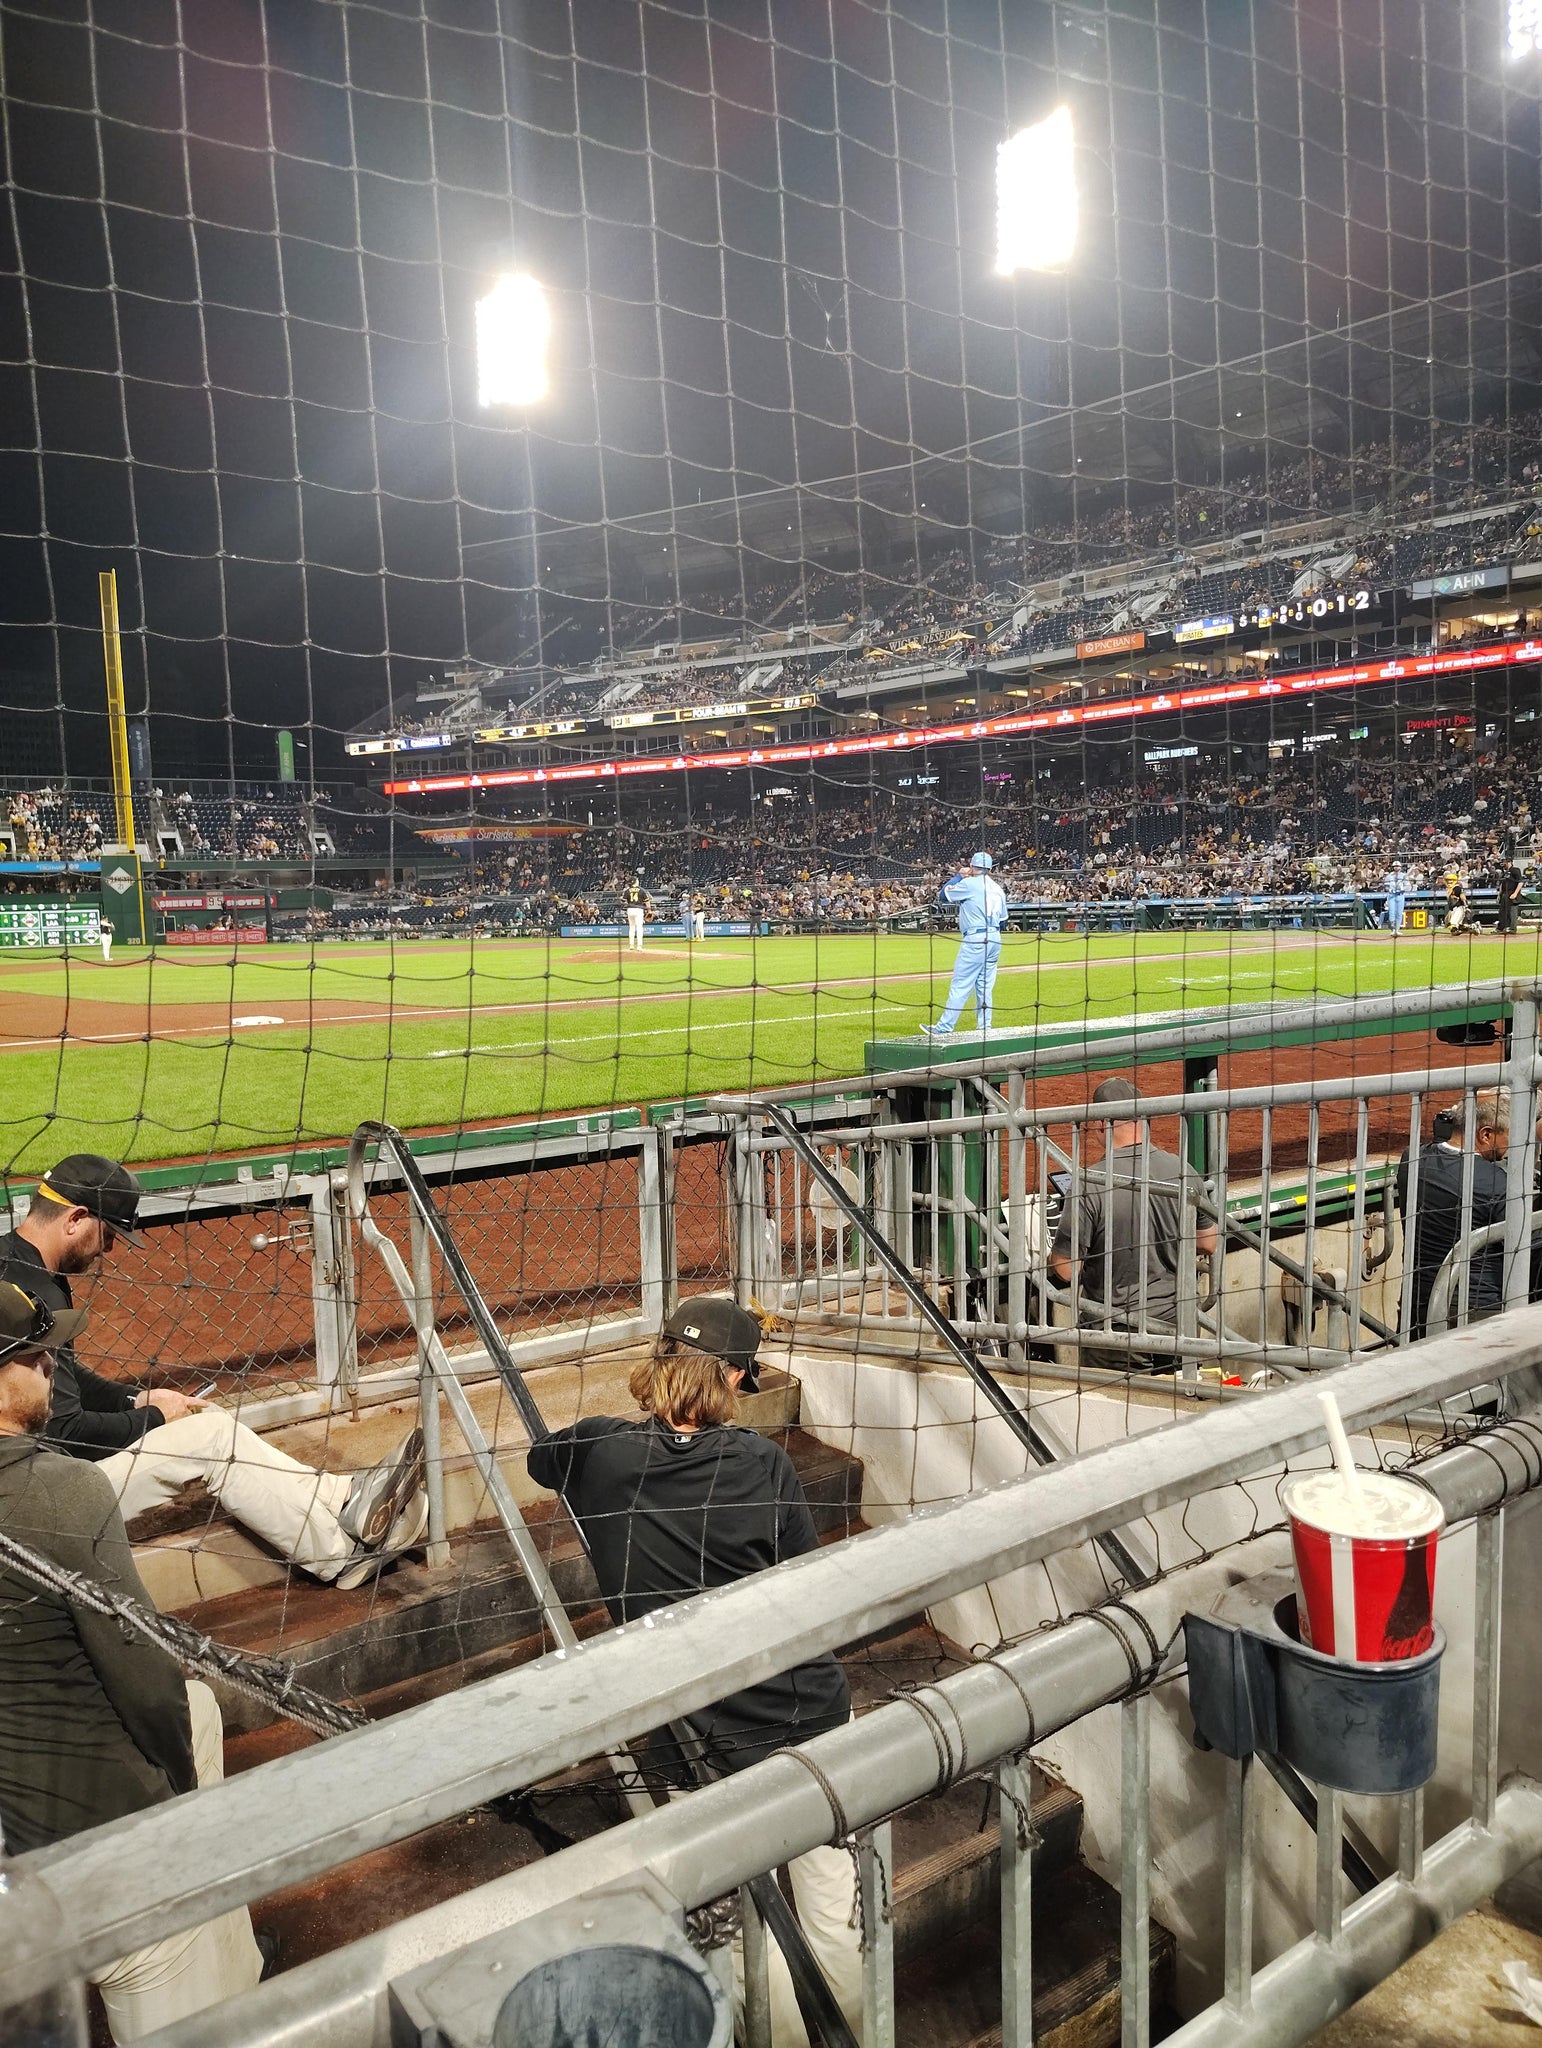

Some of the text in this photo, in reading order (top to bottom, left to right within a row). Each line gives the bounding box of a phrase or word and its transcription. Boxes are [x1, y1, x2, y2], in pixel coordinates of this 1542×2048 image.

[1453, 573, 1486, 590] AHN
[1312, 598, 1327, 616] 0
[1328, 602, 1334, 610] S
[1336, 595, 1345, 612] 1
[1355, 591, 1369, 610] 2
[1280, 605, 1287, 614] 9
[1295, 612, 1303, 621] 0
[1182, 630, 1204, 642] PIRATES
[1094, 640, 1112, 650] PNC
[1406, 718, 1450, 731] PRIMANTI
[477, 829, 514, 840] Surfside
[630, 893, 638, 901] 14
